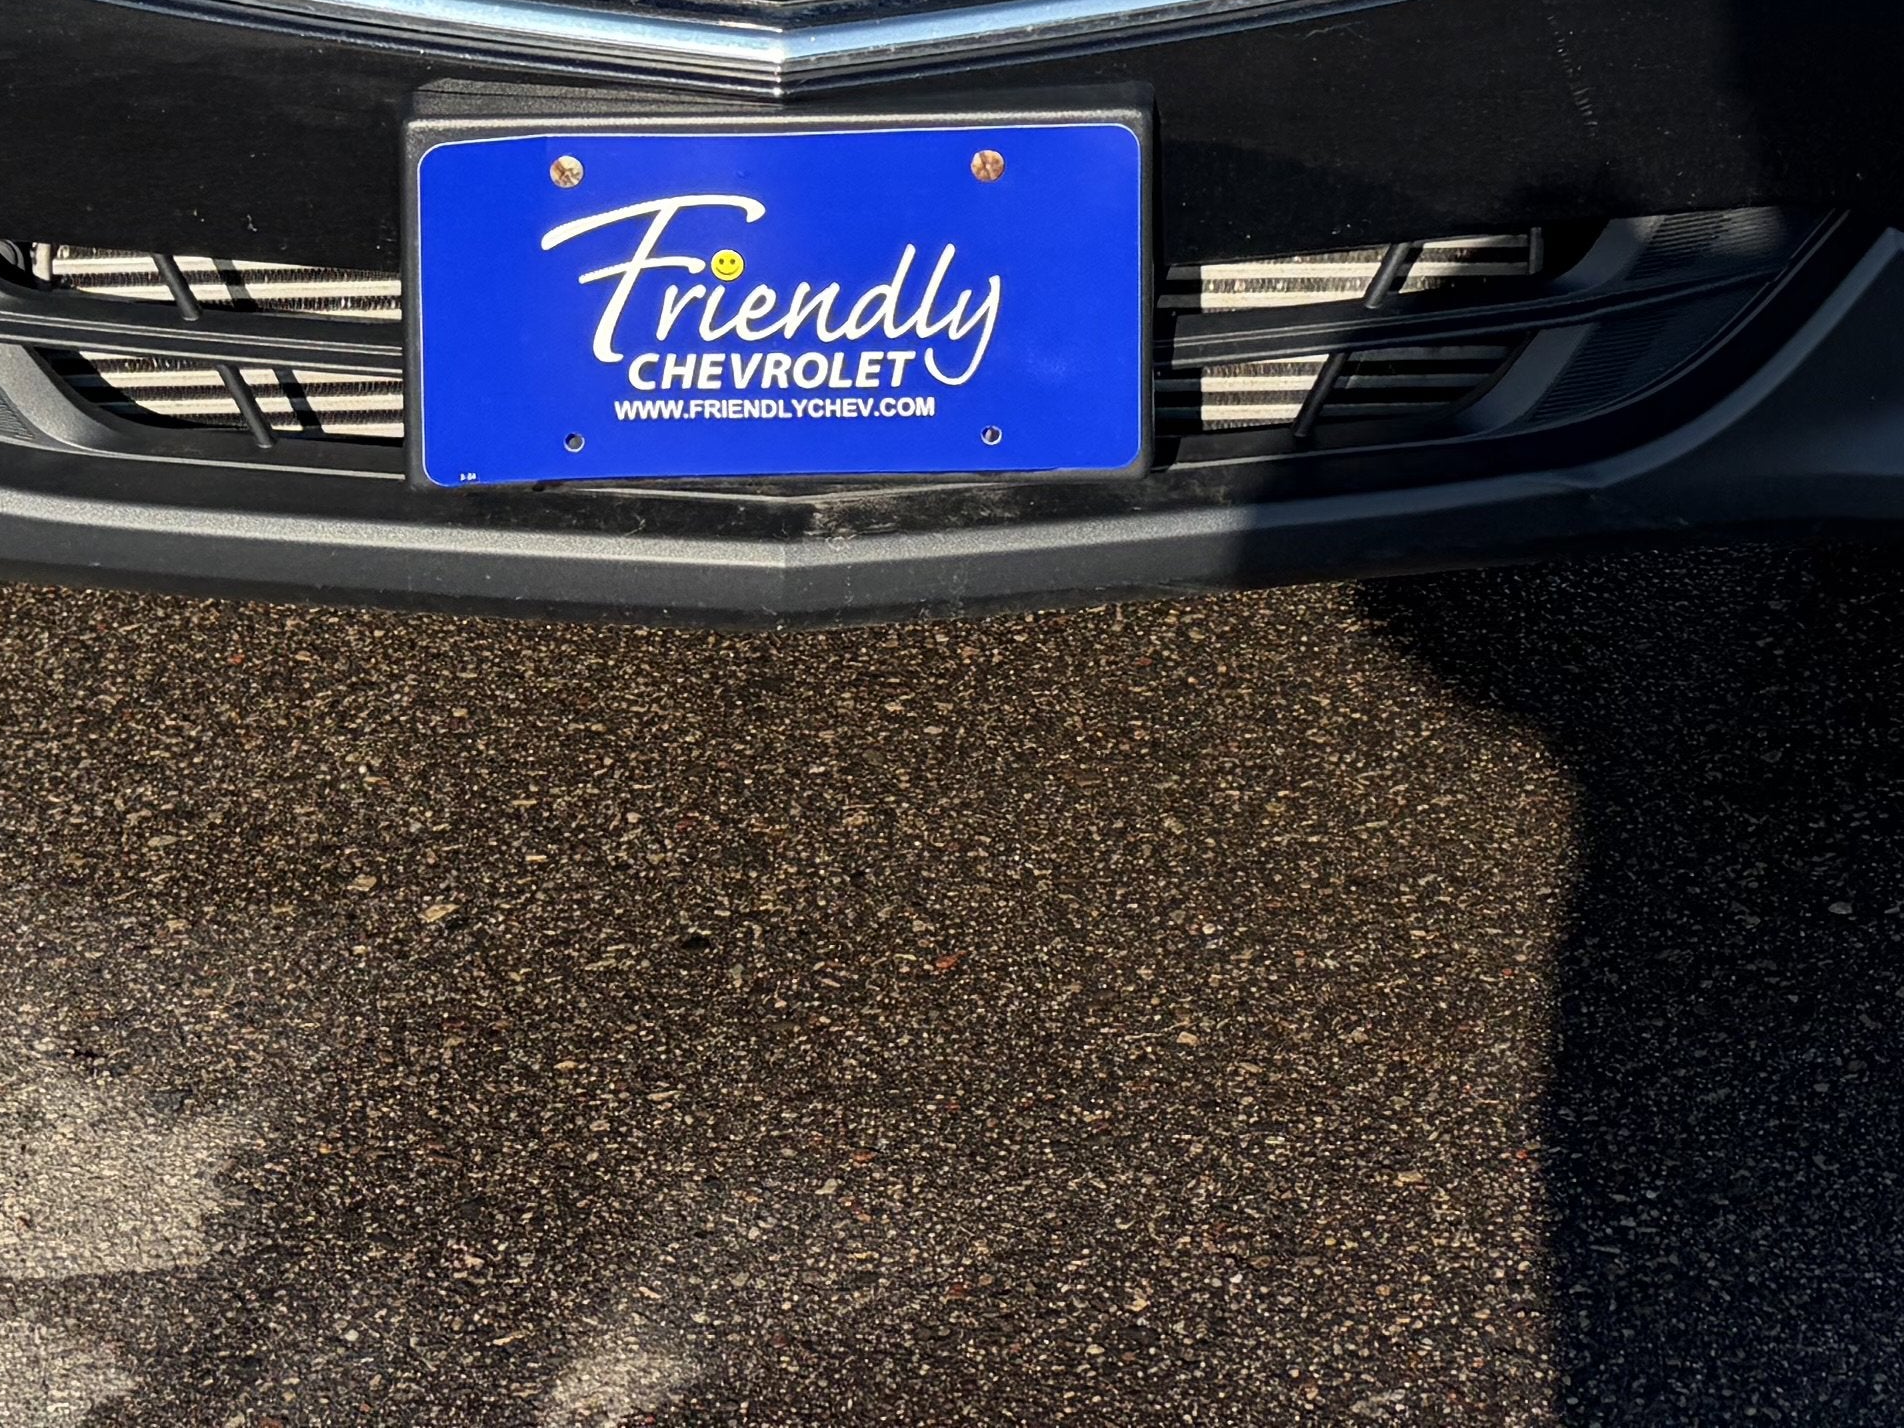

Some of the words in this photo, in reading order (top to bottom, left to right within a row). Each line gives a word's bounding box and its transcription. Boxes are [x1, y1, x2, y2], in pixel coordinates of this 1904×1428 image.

[540, 194, 1002, 386] Friendly
[628, 350, 917, 391] CHEVROLET
[613, 396, 937, 421] WWW.FRIENDLYCHEV.COM
